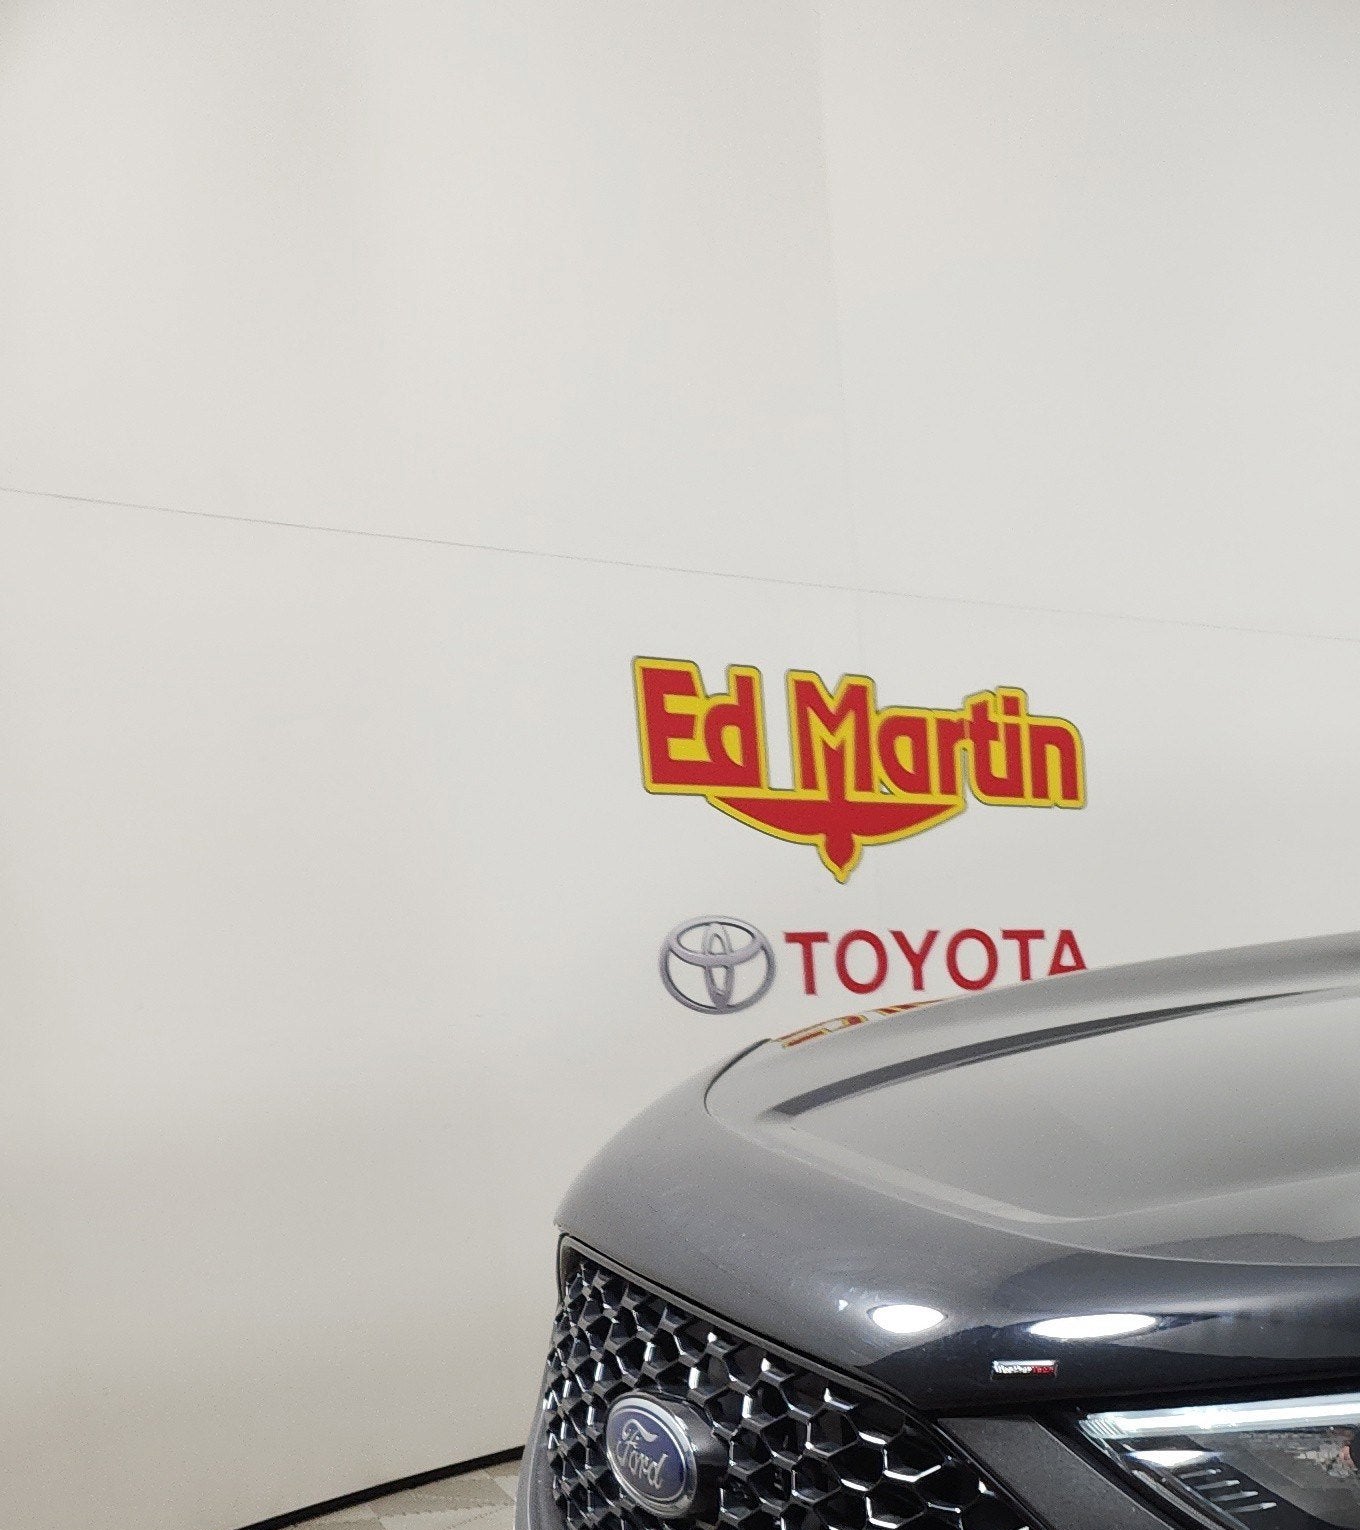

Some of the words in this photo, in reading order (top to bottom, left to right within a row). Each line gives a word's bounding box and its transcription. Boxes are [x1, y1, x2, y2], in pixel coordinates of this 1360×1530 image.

[635, 658, 765, 791] Ed
[788, 671, 1083, 806] Martin
[784, 929, 1088, 995] TOYOTA
[616, 1418, 669, 1490] Ford
